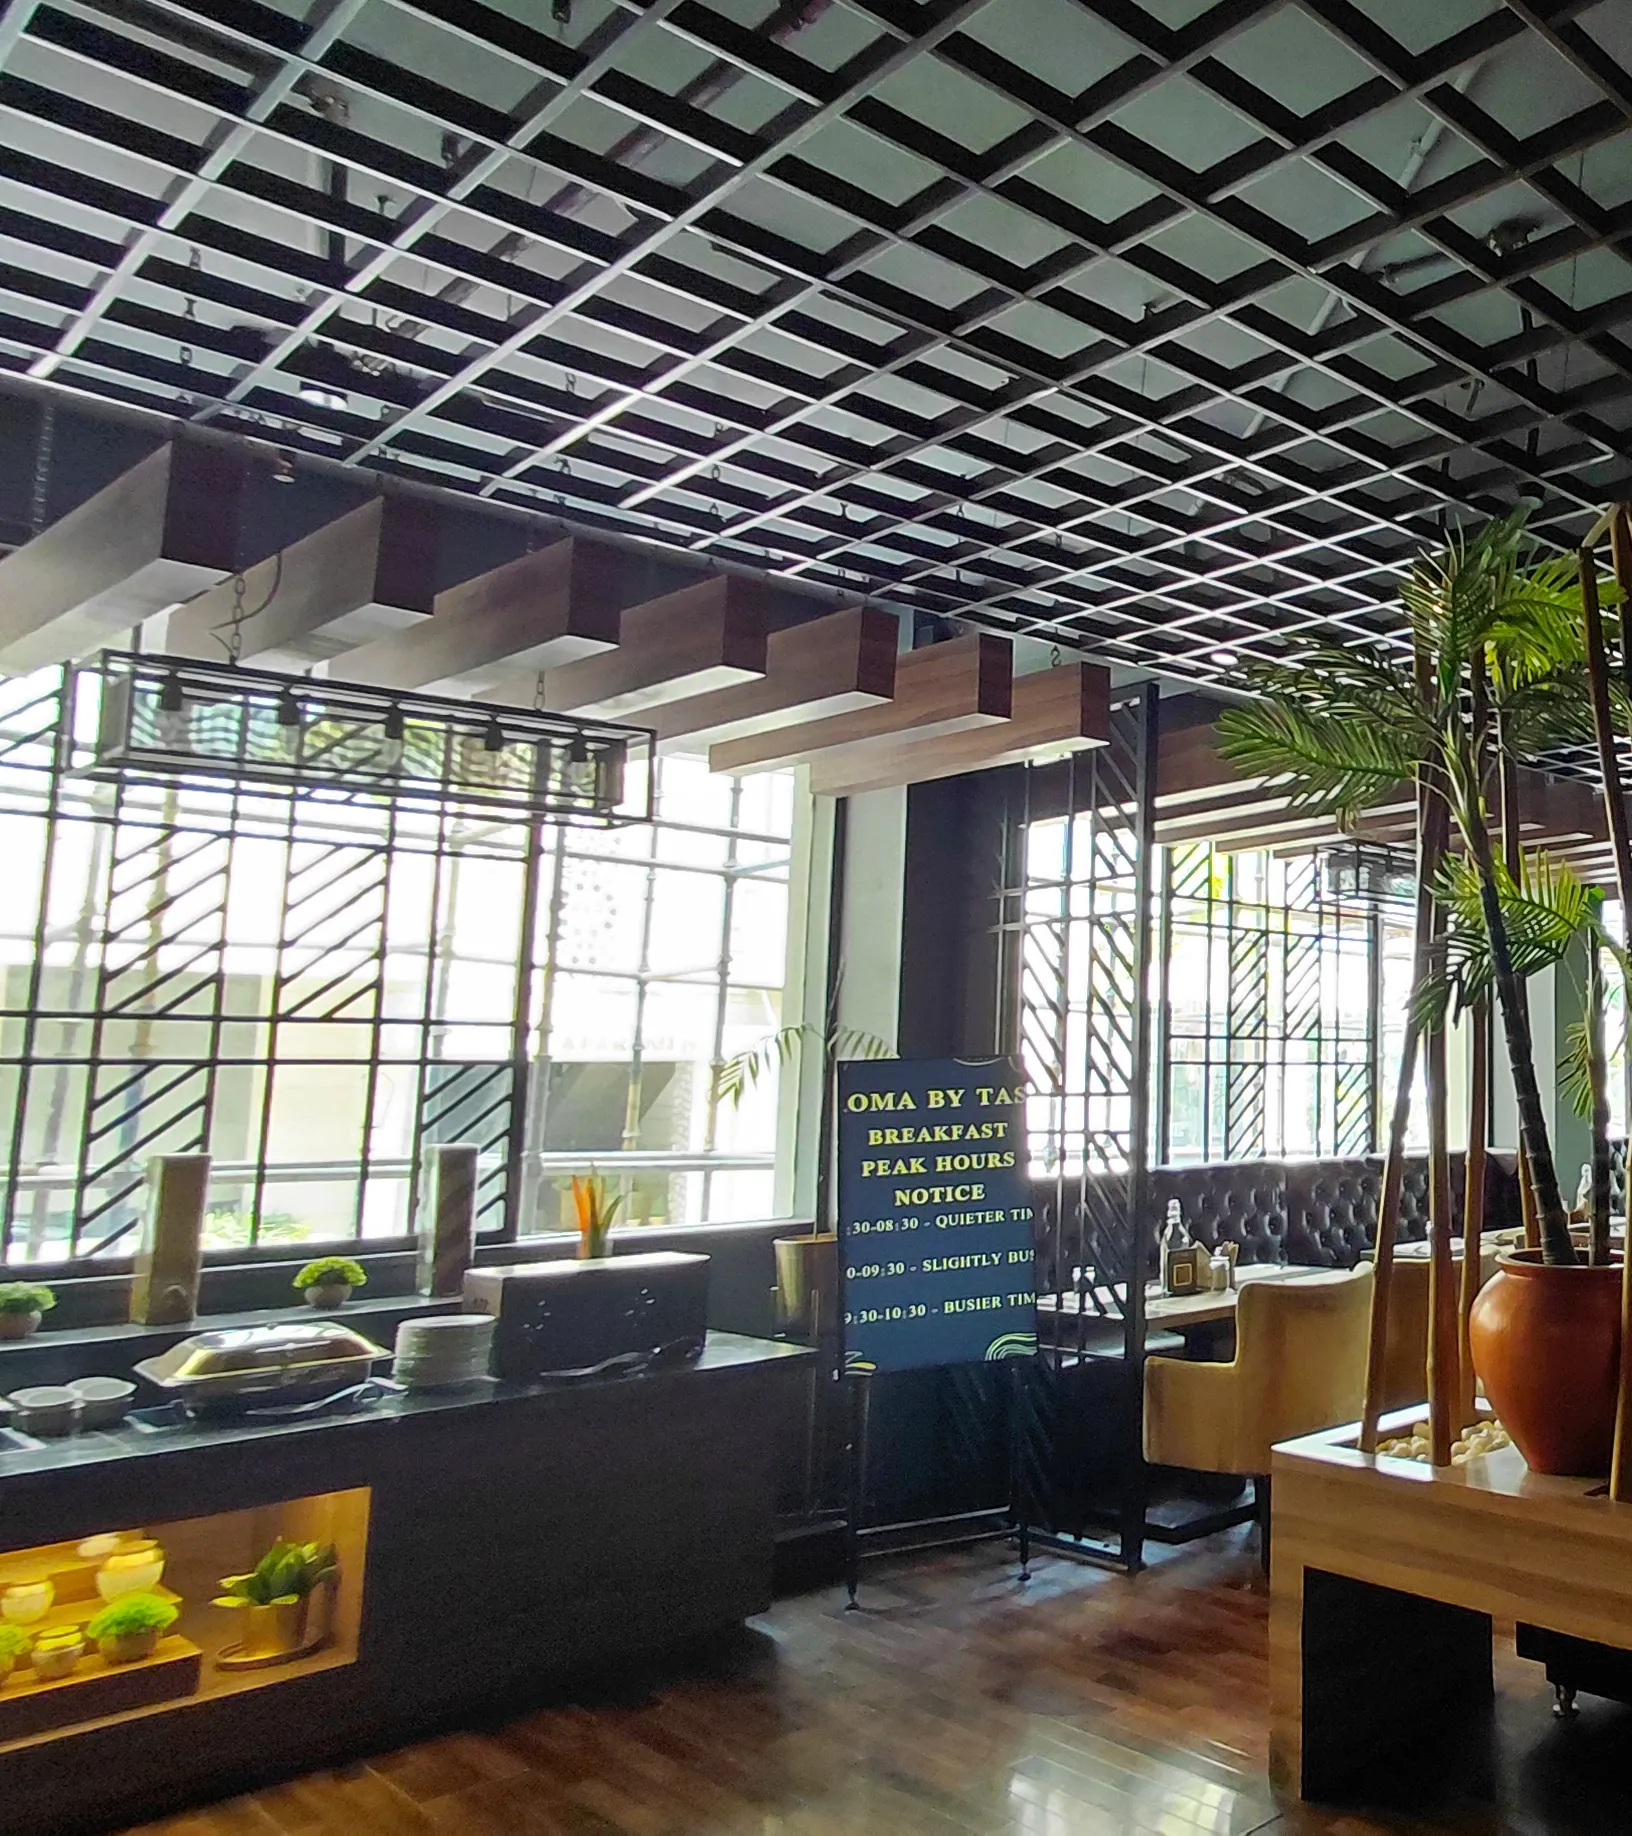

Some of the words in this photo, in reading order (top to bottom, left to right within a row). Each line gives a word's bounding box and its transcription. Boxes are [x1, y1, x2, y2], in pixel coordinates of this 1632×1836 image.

[843, 1091, 917, 1113] OMA
[927, 1089, 966, 1109] BY
[868, 1122, 1008, 1146] BREAKFAST
[861, 1157, 928, 1177] PEAK
[935, 1151, 1015, 1173] HOURS
[895, 1184, 985, 1207] NOTICE
[935, 1210, 1005, 1229] QUIETER
[922, 1252, 1002, 1272] SLIGHTLY
[944, 1296, 1002, 1314] BUSIER
